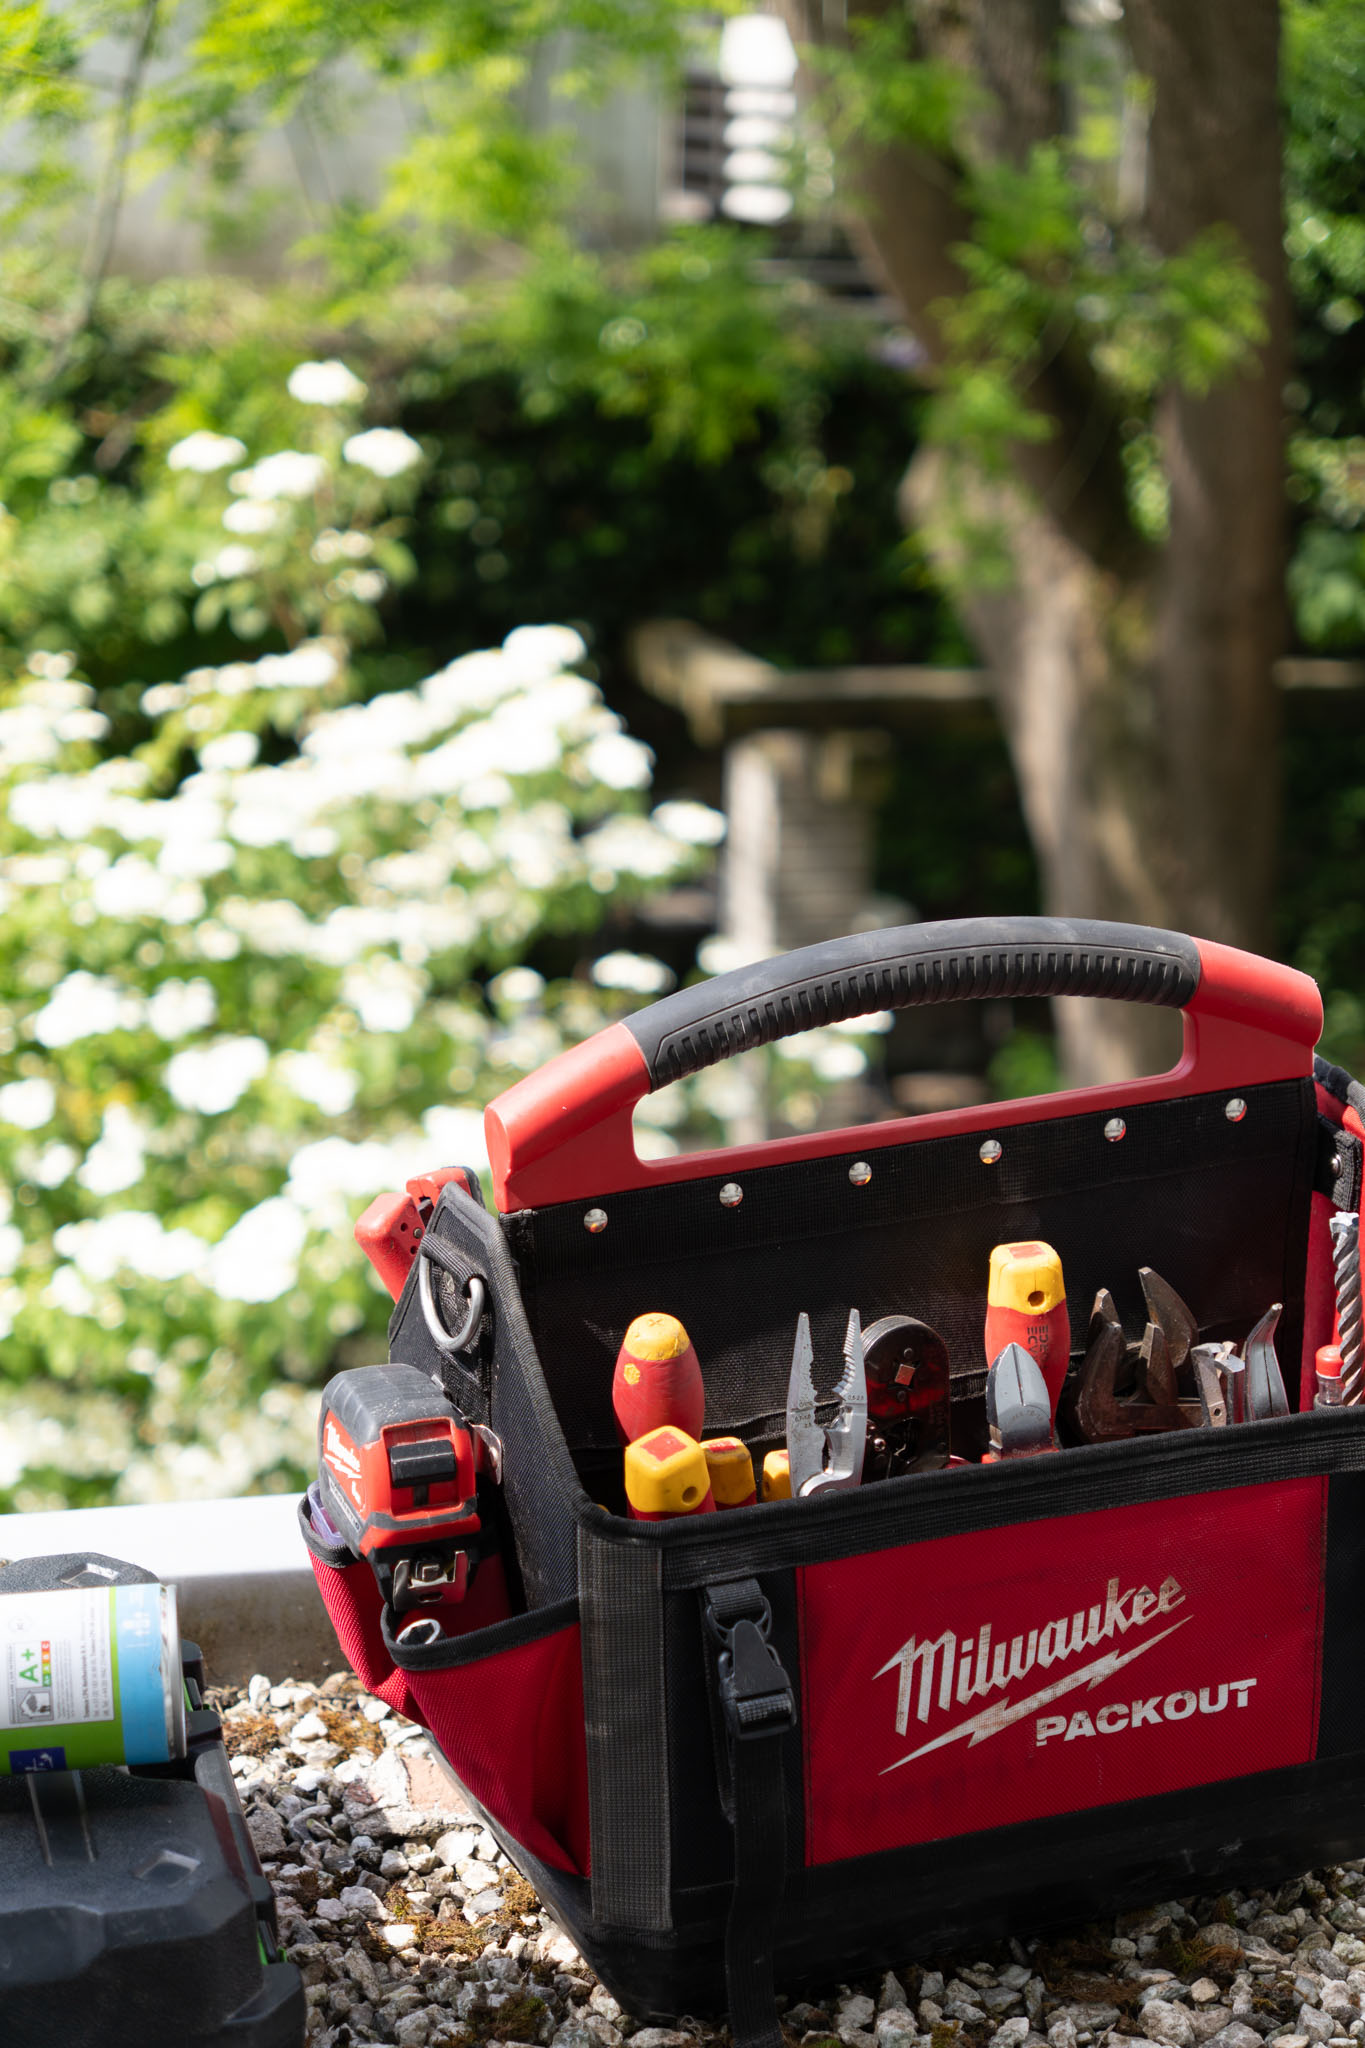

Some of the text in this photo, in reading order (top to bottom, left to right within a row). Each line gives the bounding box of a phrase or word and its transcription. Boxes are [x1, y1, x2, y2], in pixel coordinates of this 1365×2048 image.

[19, 1648, 39, 1683] A+
[871, 1575, 1187, 1737] Milwaukee
[1035, 1677, 1258, 1747] PACKOUT
